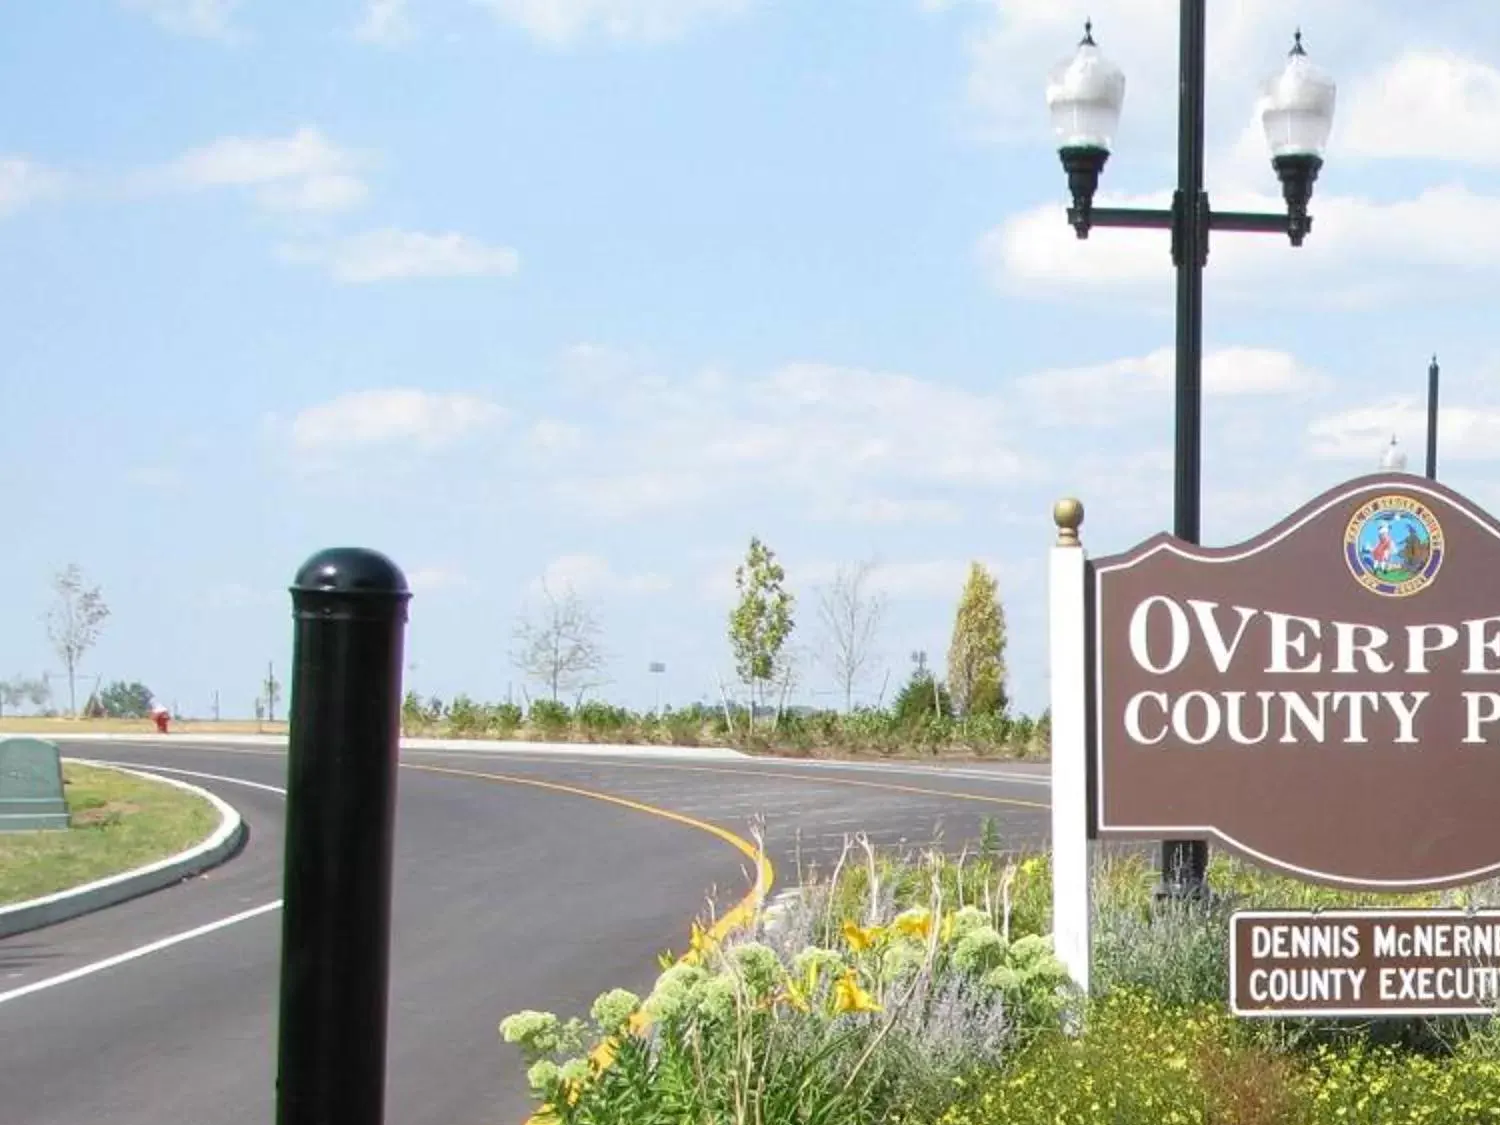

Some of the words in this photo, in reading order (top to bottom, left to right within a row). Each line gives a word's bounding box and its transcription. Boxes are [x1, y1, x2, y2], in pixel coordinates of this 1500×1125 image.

[1123, 690, 1430, 745] COUNTY
[1252, 925, 1360, 959] DENNIS
[1249, 968, 1367, 1002] COUNTY
